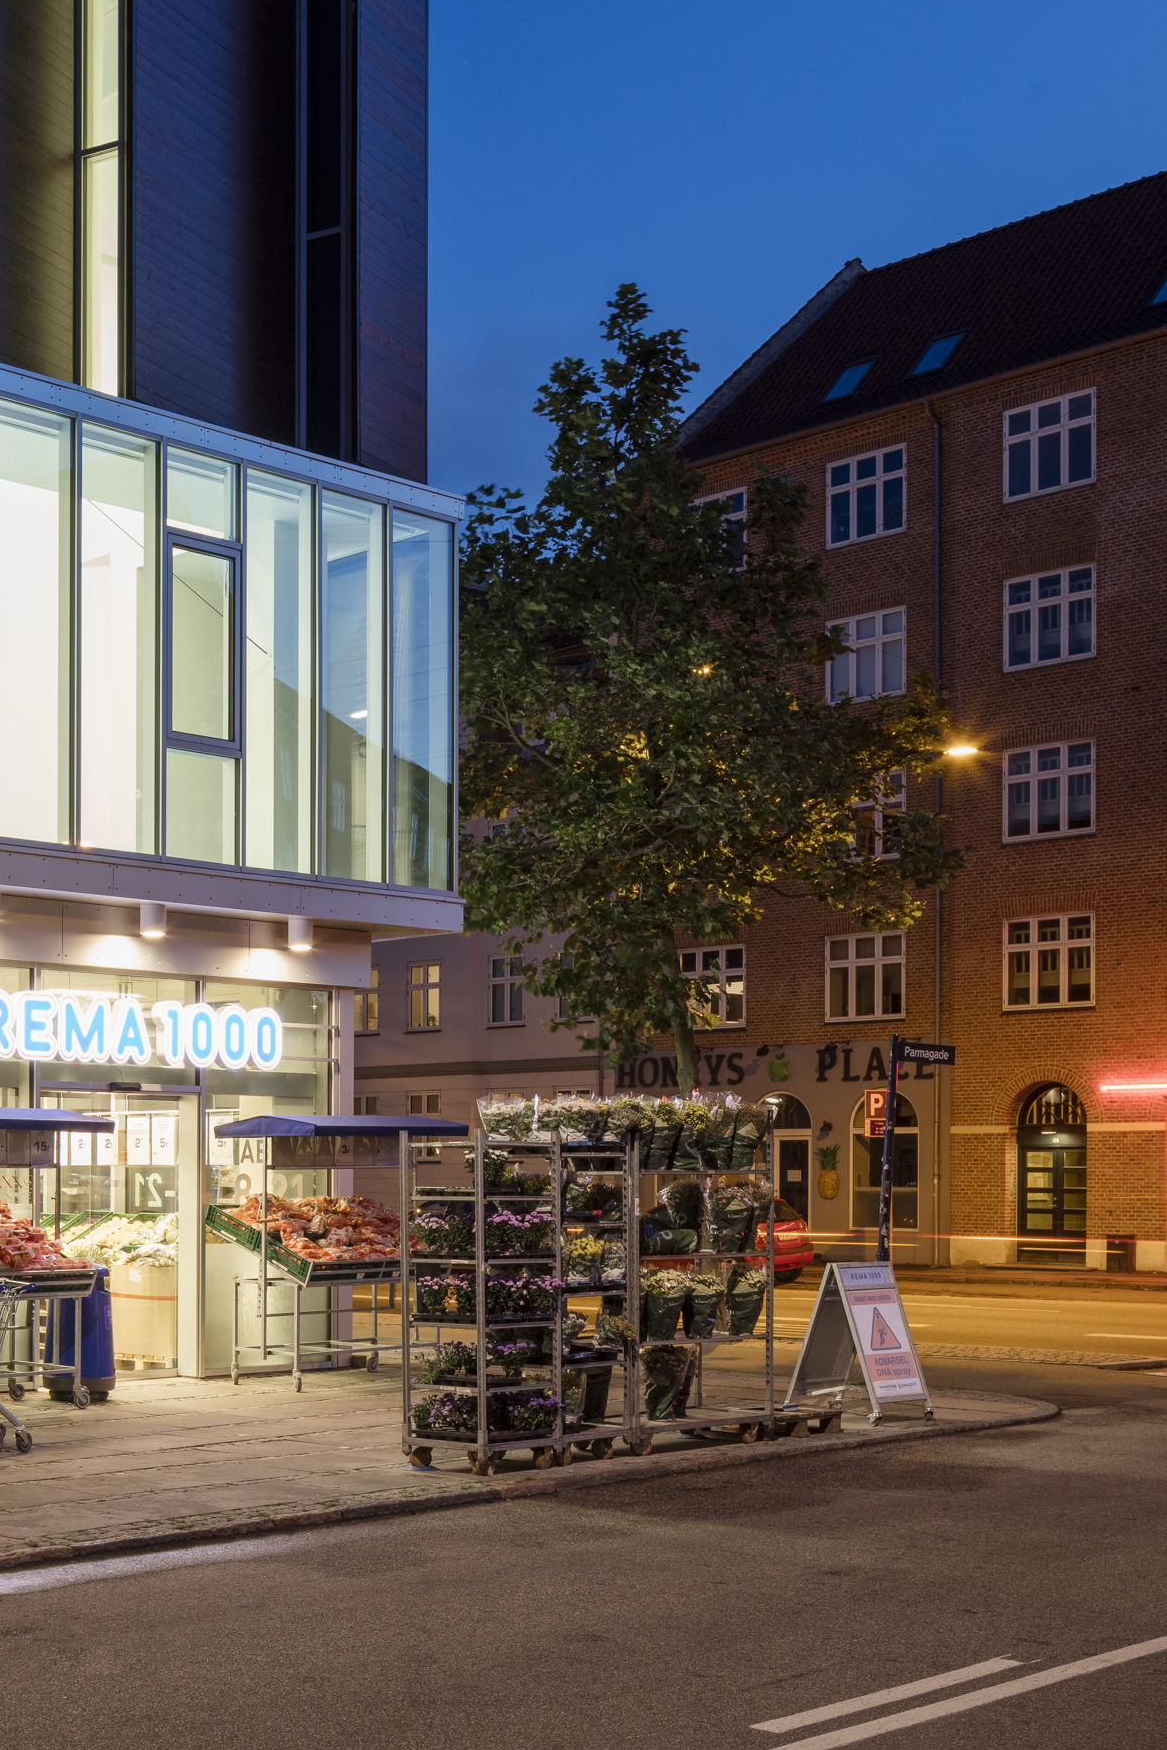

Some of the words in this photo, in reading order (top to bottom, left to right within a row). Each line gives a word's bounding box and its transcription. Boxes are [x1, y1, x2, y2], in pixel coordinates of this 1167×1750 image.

[161, 1005, 279, 1066] 1000
[904, 1046, 949, 1061] Parmagade
[616, 1052, 745, 1088] HONYS
[870, 1093, 884, 1117] P
[874, 1355, 910, 1366] ADVARSEL
[875, 1367, 893, 1377] DNA
[893, 1367, 911, 1377] spray
